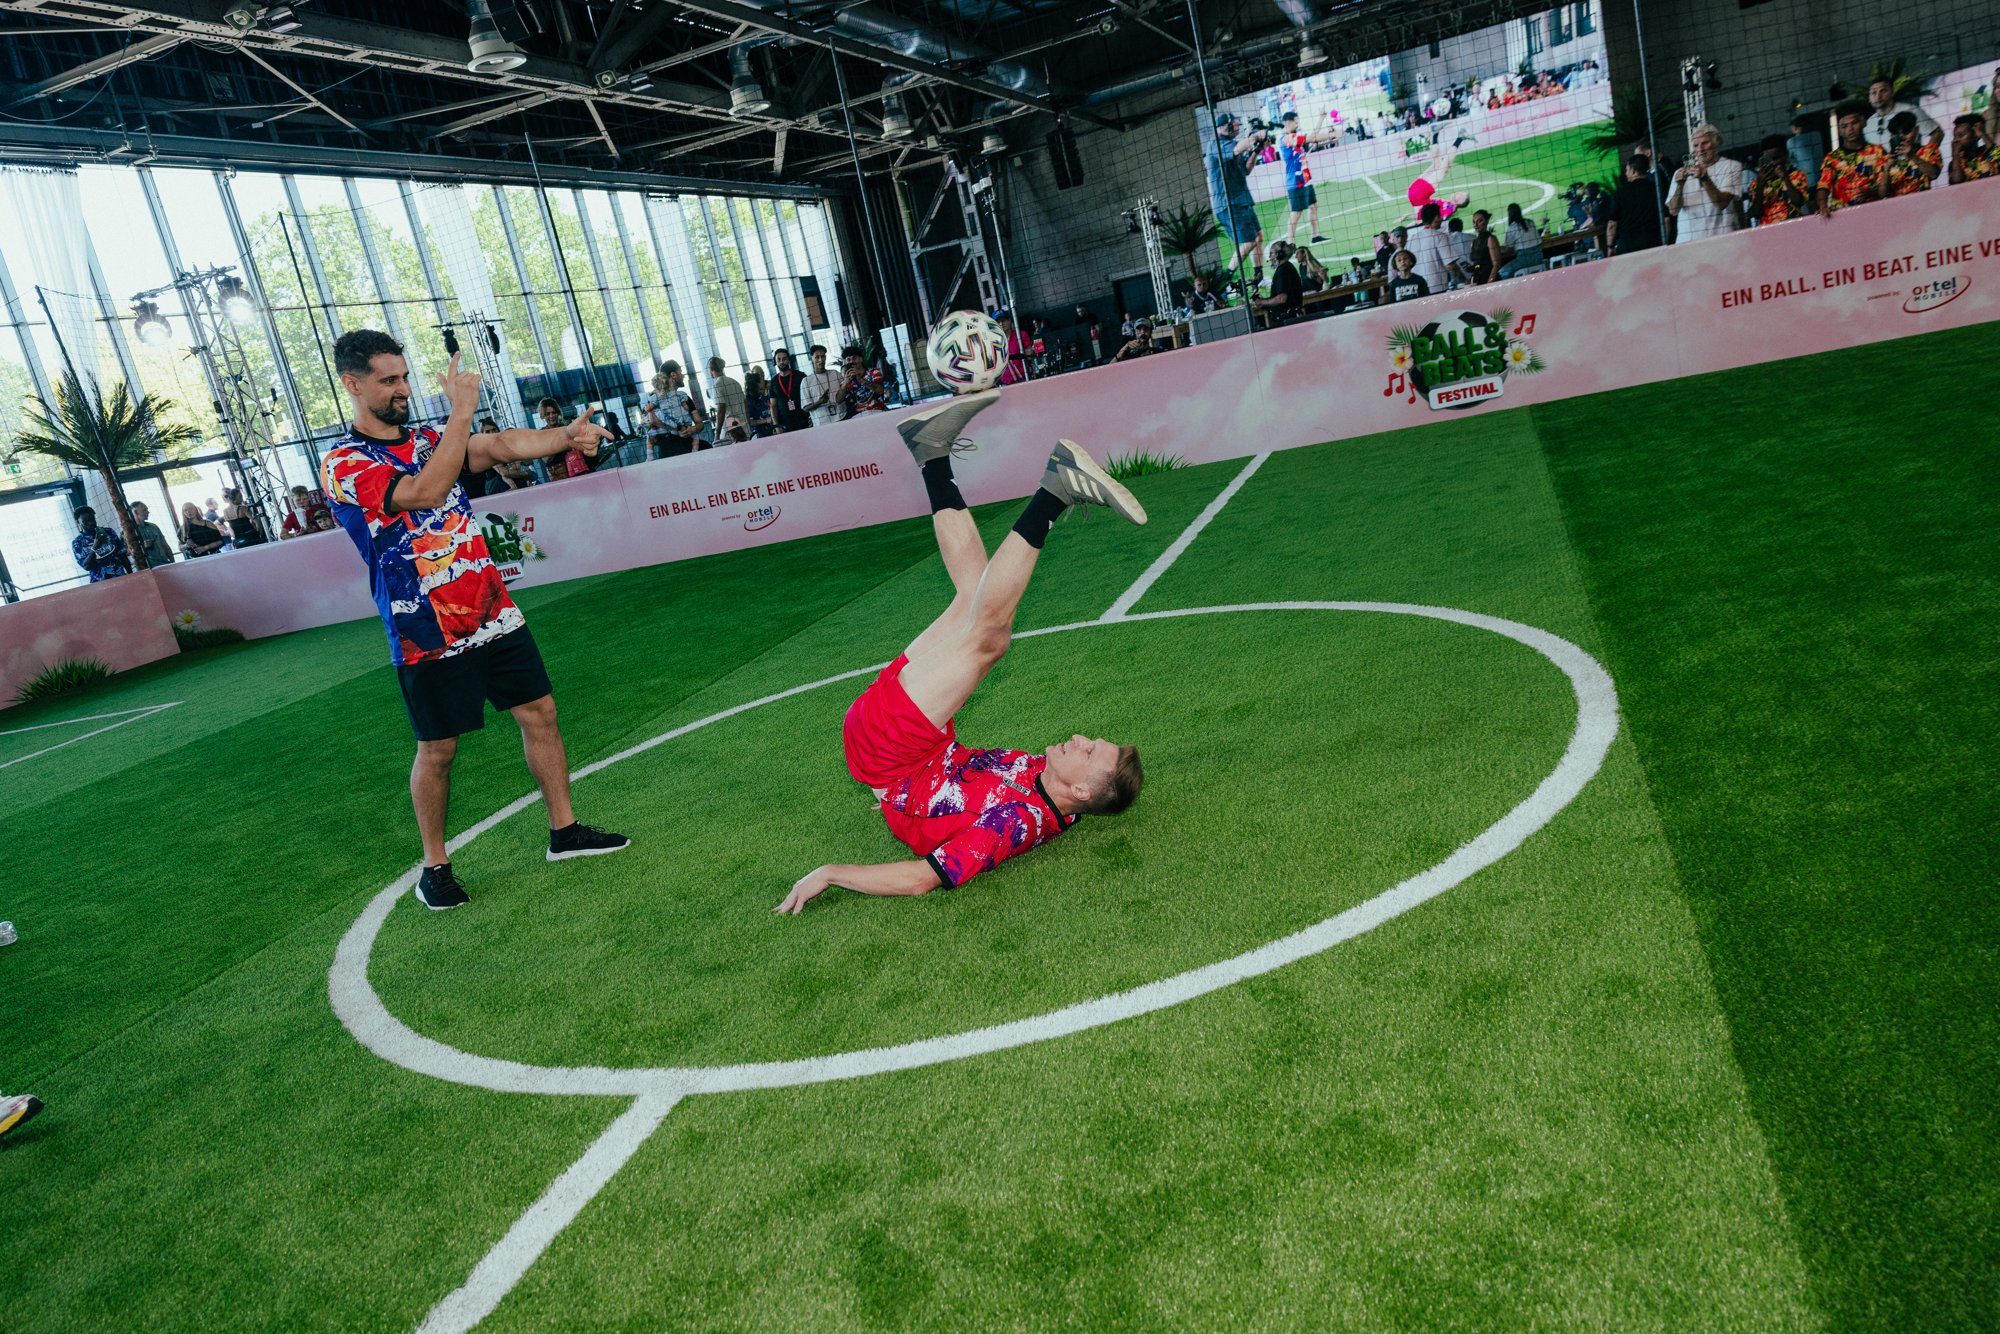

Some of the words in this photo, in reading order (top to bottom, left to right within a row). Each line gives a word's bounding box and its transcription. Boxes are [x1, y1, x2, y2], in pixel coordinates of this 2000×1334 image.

[1721, 287, 1752, 309] EIN
[1760, 277, 1816, 301] BALL.
[1823, 267, 1856, 288] EIN
[1863, 255, 1919, 280] BEAT.
[1926, 243, 1973, 268] EINE
[1912, 277, 1957, 296] ortel
[1914, 289, 1957, 302] MOBILE
[1411, 326, 1483, 363] BALL
[1484, 322, 1507, 348] &
[1420, 349, 1504, 387] BEATS
[1437, 382, 1499, 404] FESTIVAL
[649, 504, 670, 519] EIN
[672, 498, 706, 515] BALL.
[708, 492, 729, 508] EIN
[730, 486, 765, 504] BEAT.
[767, 479, 795, 497] EINE
[797, 462, 884, 491] VERBINDUNG.
[434, 505, 465, 523] OBILE
[747, 506, 773, 519] ortel
[749, 515, 774, 523] MOBILE
[482, 524, 506, 545] LL
[498, 566, 521, 578] TIVAL
